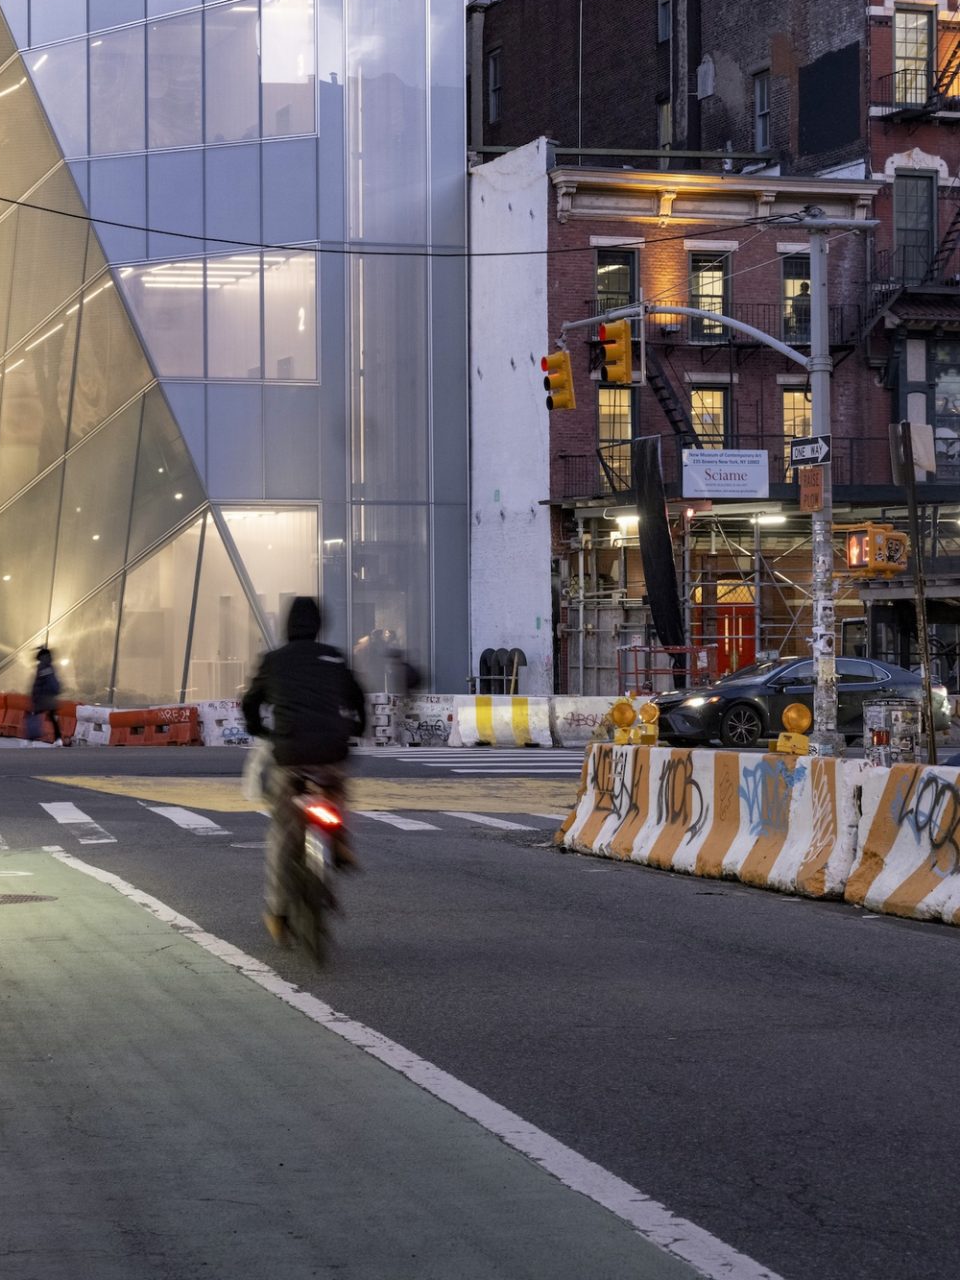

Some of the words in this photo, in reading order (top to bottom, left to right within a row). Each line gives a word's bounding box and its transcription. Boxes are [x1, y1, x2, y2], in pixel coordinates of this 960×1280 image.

[794, 447, 806, 459] ONE
[810, 444, 824, 456] WAY
[704, 467, 748, 481] Sciame
[803, 472, 820, 488] RAISE
[803, 492, 820, 508] PLOW
